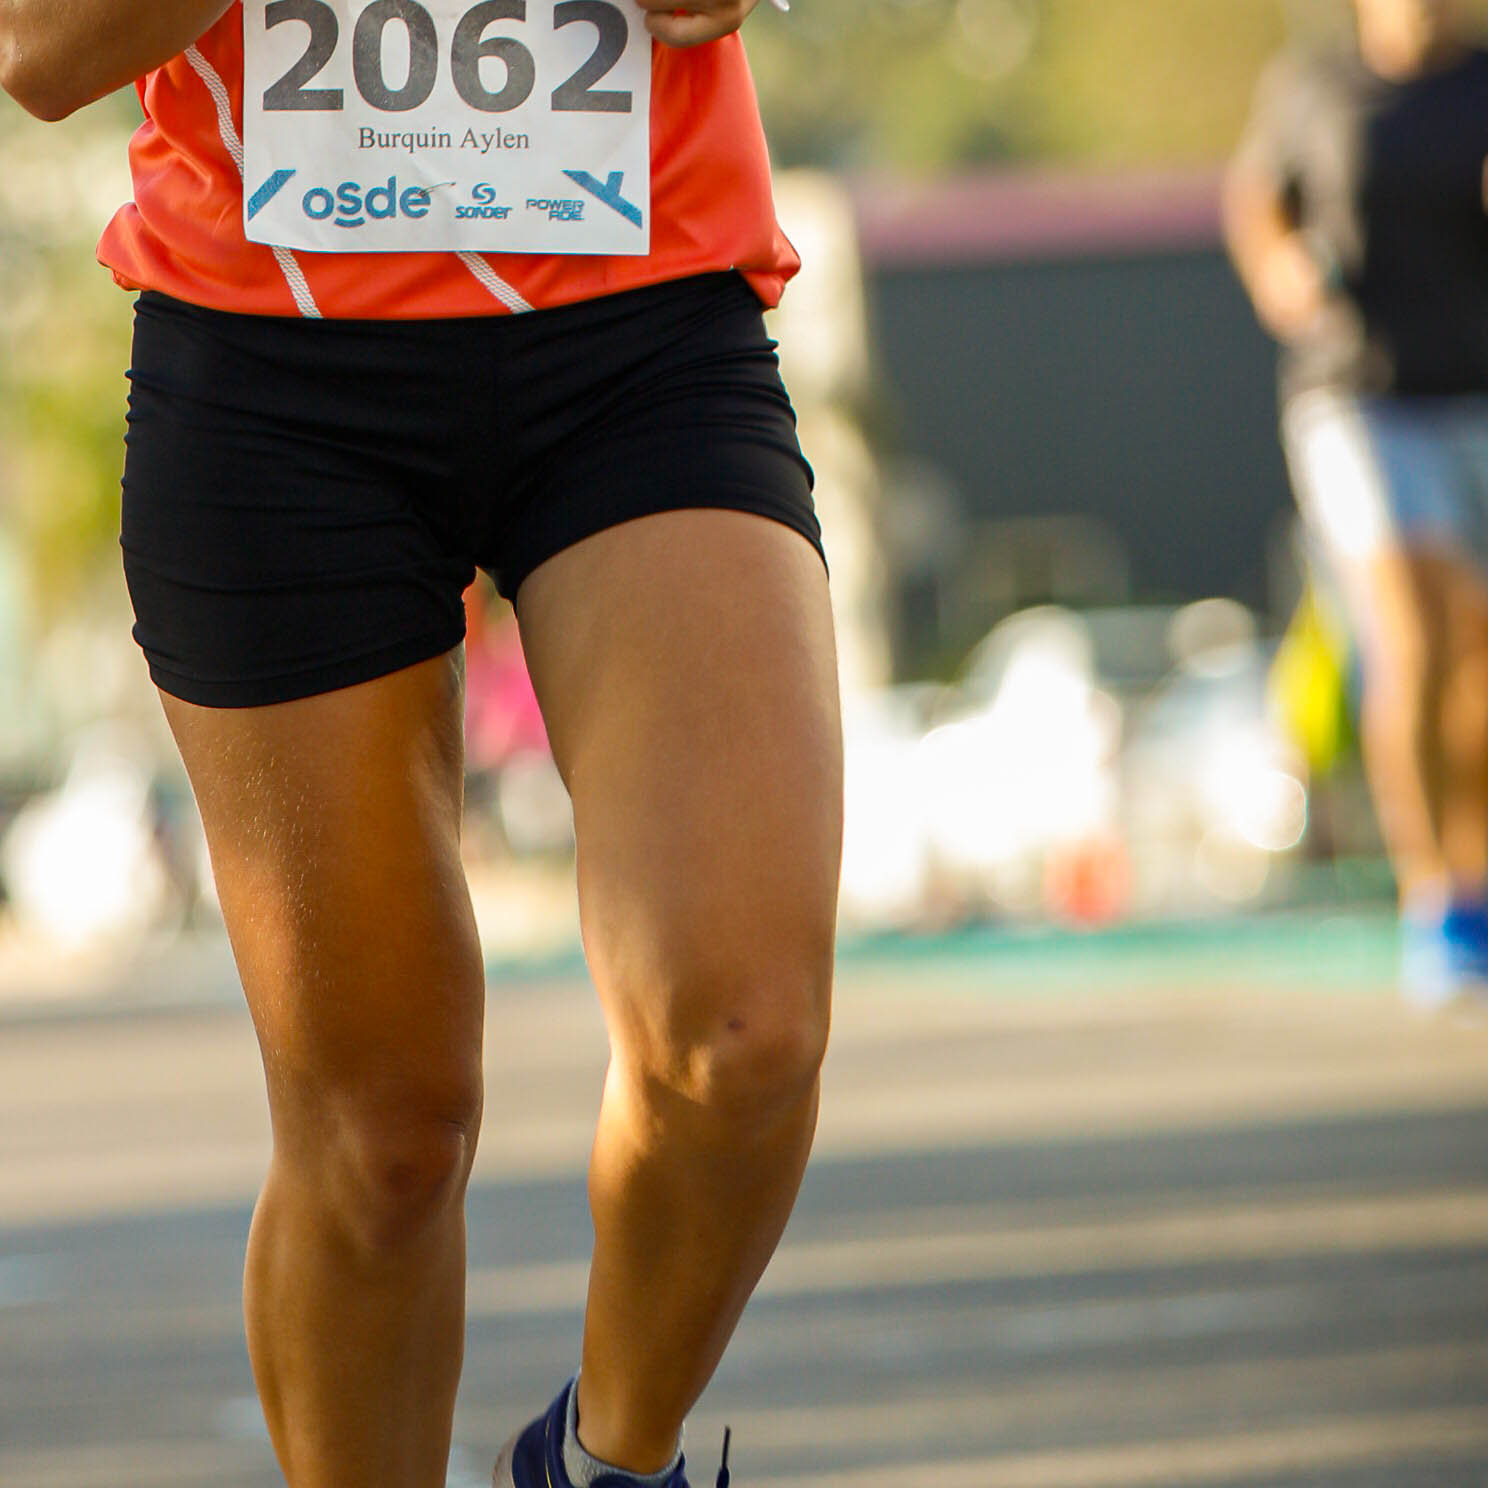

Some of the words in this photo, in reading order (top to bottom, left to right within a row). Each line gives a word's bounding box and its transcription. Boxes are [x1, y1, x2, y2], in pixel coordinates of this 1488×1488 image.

[358, 126, 451, 154] Burquin
[460, 127, 529, 154] Aylen
[302, 176, 432, 220] osde
[526, 199, 585, 210] POWER
